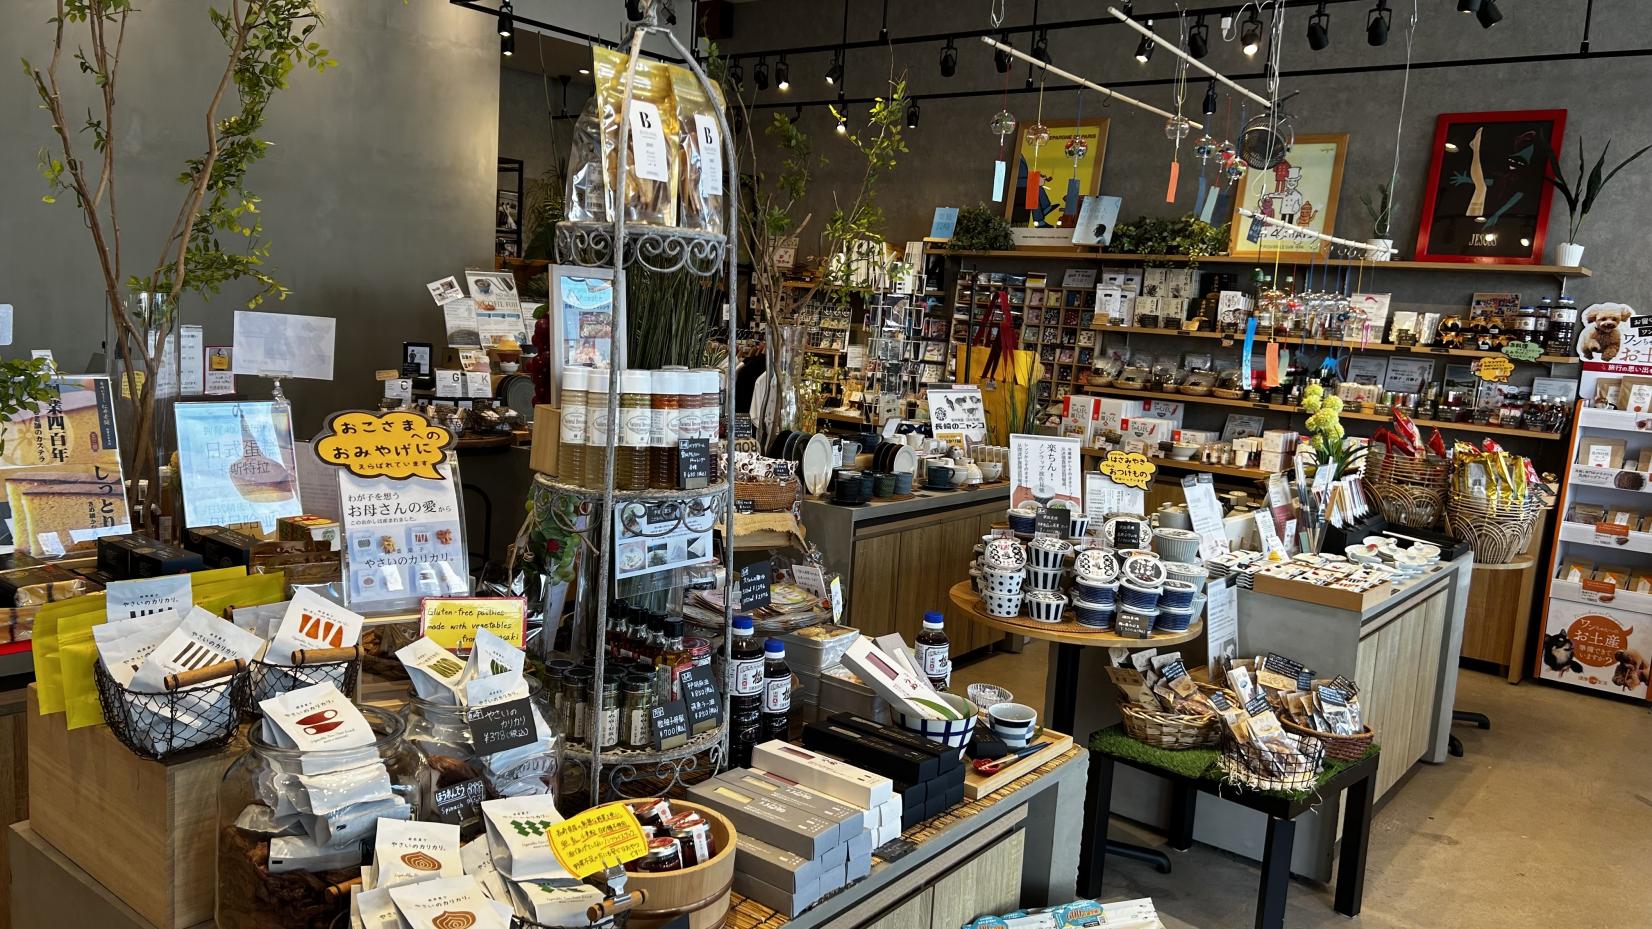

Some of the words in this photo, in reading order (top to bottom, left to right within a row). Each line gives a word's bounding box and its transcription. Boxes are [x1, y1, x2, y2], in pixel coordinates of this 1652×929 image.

[640, 111, 651, 129] B
[704, 127, 712, 144] B
[452, 373, 460, 382] G
[333, 443, 432, 459] おみやげに
[358, 460, 429, 470] えらばれています
[1110, 456, 1146, 465] はさみやき
[1110, 468, 1147, 478] おつけもの
[348, 492, 400, 502] わが子を想う
[348, 499, 452, 517] お母さんの愛から
[123, 597, 179, 607] やさいのカリカリ。
[427, 608, 474, 616] Gluten-free
[427, 622, 445, 630] made
[450, 622, 467, 630] with
[1573, 630, 1620, 648] お土産
[191, 631, 238, 659] やさいのカリカリ。
[436, 785, 465, 802] ほうれんそう
[442, 803, 464, 815] Spinach
[391, 842, 446, 851] やさいのカリカリ。
